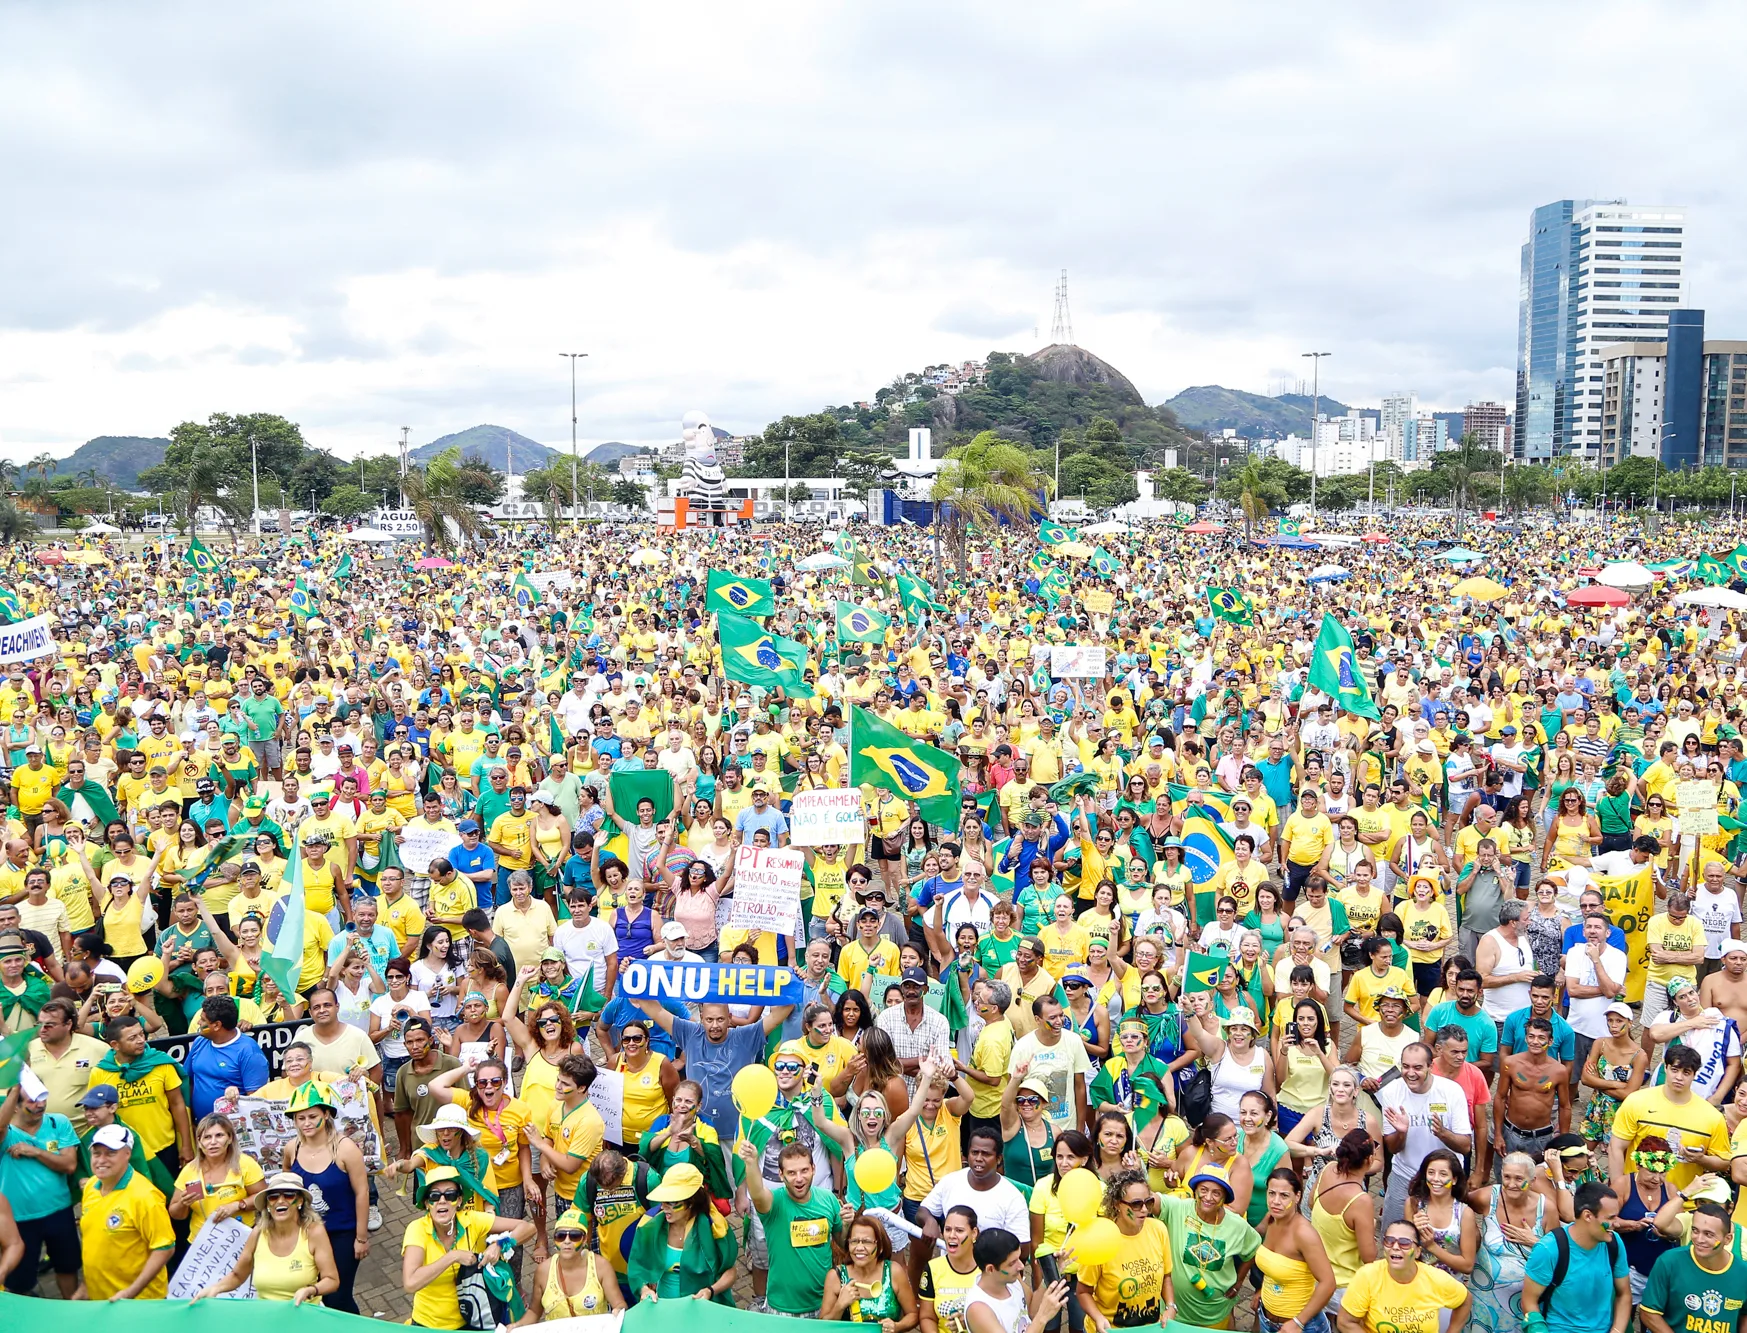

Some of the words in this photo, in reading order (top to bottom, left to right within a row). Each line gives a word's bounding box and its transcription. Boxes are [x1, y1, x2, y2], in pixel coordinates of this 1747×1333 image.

[380, 513, 417, 521] AGUA
[380, 523, 393, 532] R$
[396, 523, 418, 532] 2,50
[0, 626, 49, 656] EACHMENT
[1328, 806, 1342, 814] NIKE
[793, 812, 818, 826] NÃO
[824, 809, 831, 824] É
[517, 833, 526, 844] 11
[739, 846, 764, 868] PT
[765, 856, 803, 870] RESUMIDO
[737, 869, 778, 885] MENSALÃO
[732, 900, 777, 915] PETROLÃO
[1702, 918, 1728, 927] NEGRO
[1662, 941, 1691, 949] DILMA!
[622, 963, 711, 1000] ONU
[718, 967, 792, 997] HELP
[1034, 1052, 1055, 1061] 1993
[1694, 1041, 1723, 1085] CONFIA
[116, 1079, 147, 1091] FORA
[120, 1086, 153, 1099] ILMA!
[1121, 1257, 1151, 1271] NOSSA
[1142, 1273, 1155, 1282] VAI
[1128, 1279, 1158, 1292] MUDAR
[1384, 1306, 1416, 1315] NOSSA
[1390, 1310, 1436, 1323] GERAÇÃO
[1685, 1314, 1732, 1333] BRASIL
